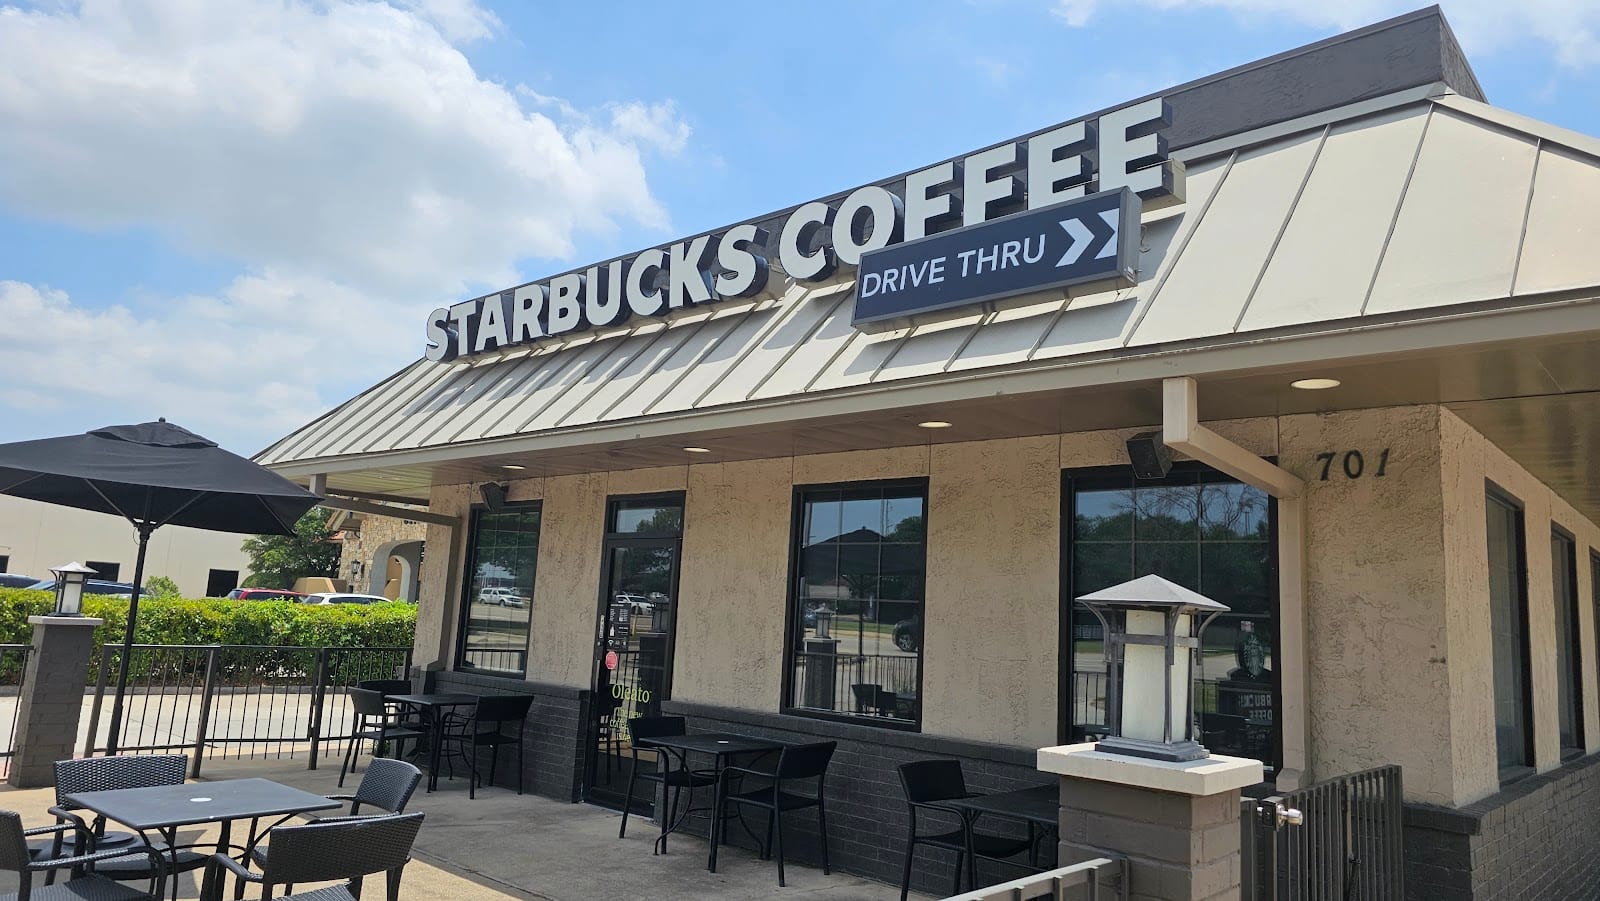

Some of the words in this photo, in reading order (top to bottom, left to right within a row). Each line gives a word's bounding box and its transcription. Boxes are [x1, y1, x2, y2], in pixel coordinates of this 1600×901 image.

[425, 224, 762, 361] STARBUCKS
[779, 96, 1165, 280] COFFEE
[861, 255, 947, 298] DRIVE
[957, 233, 1046, 278] THRU
[1316, 447, 1390, 481] 701
[612, 683, 650, 704] Oleato
